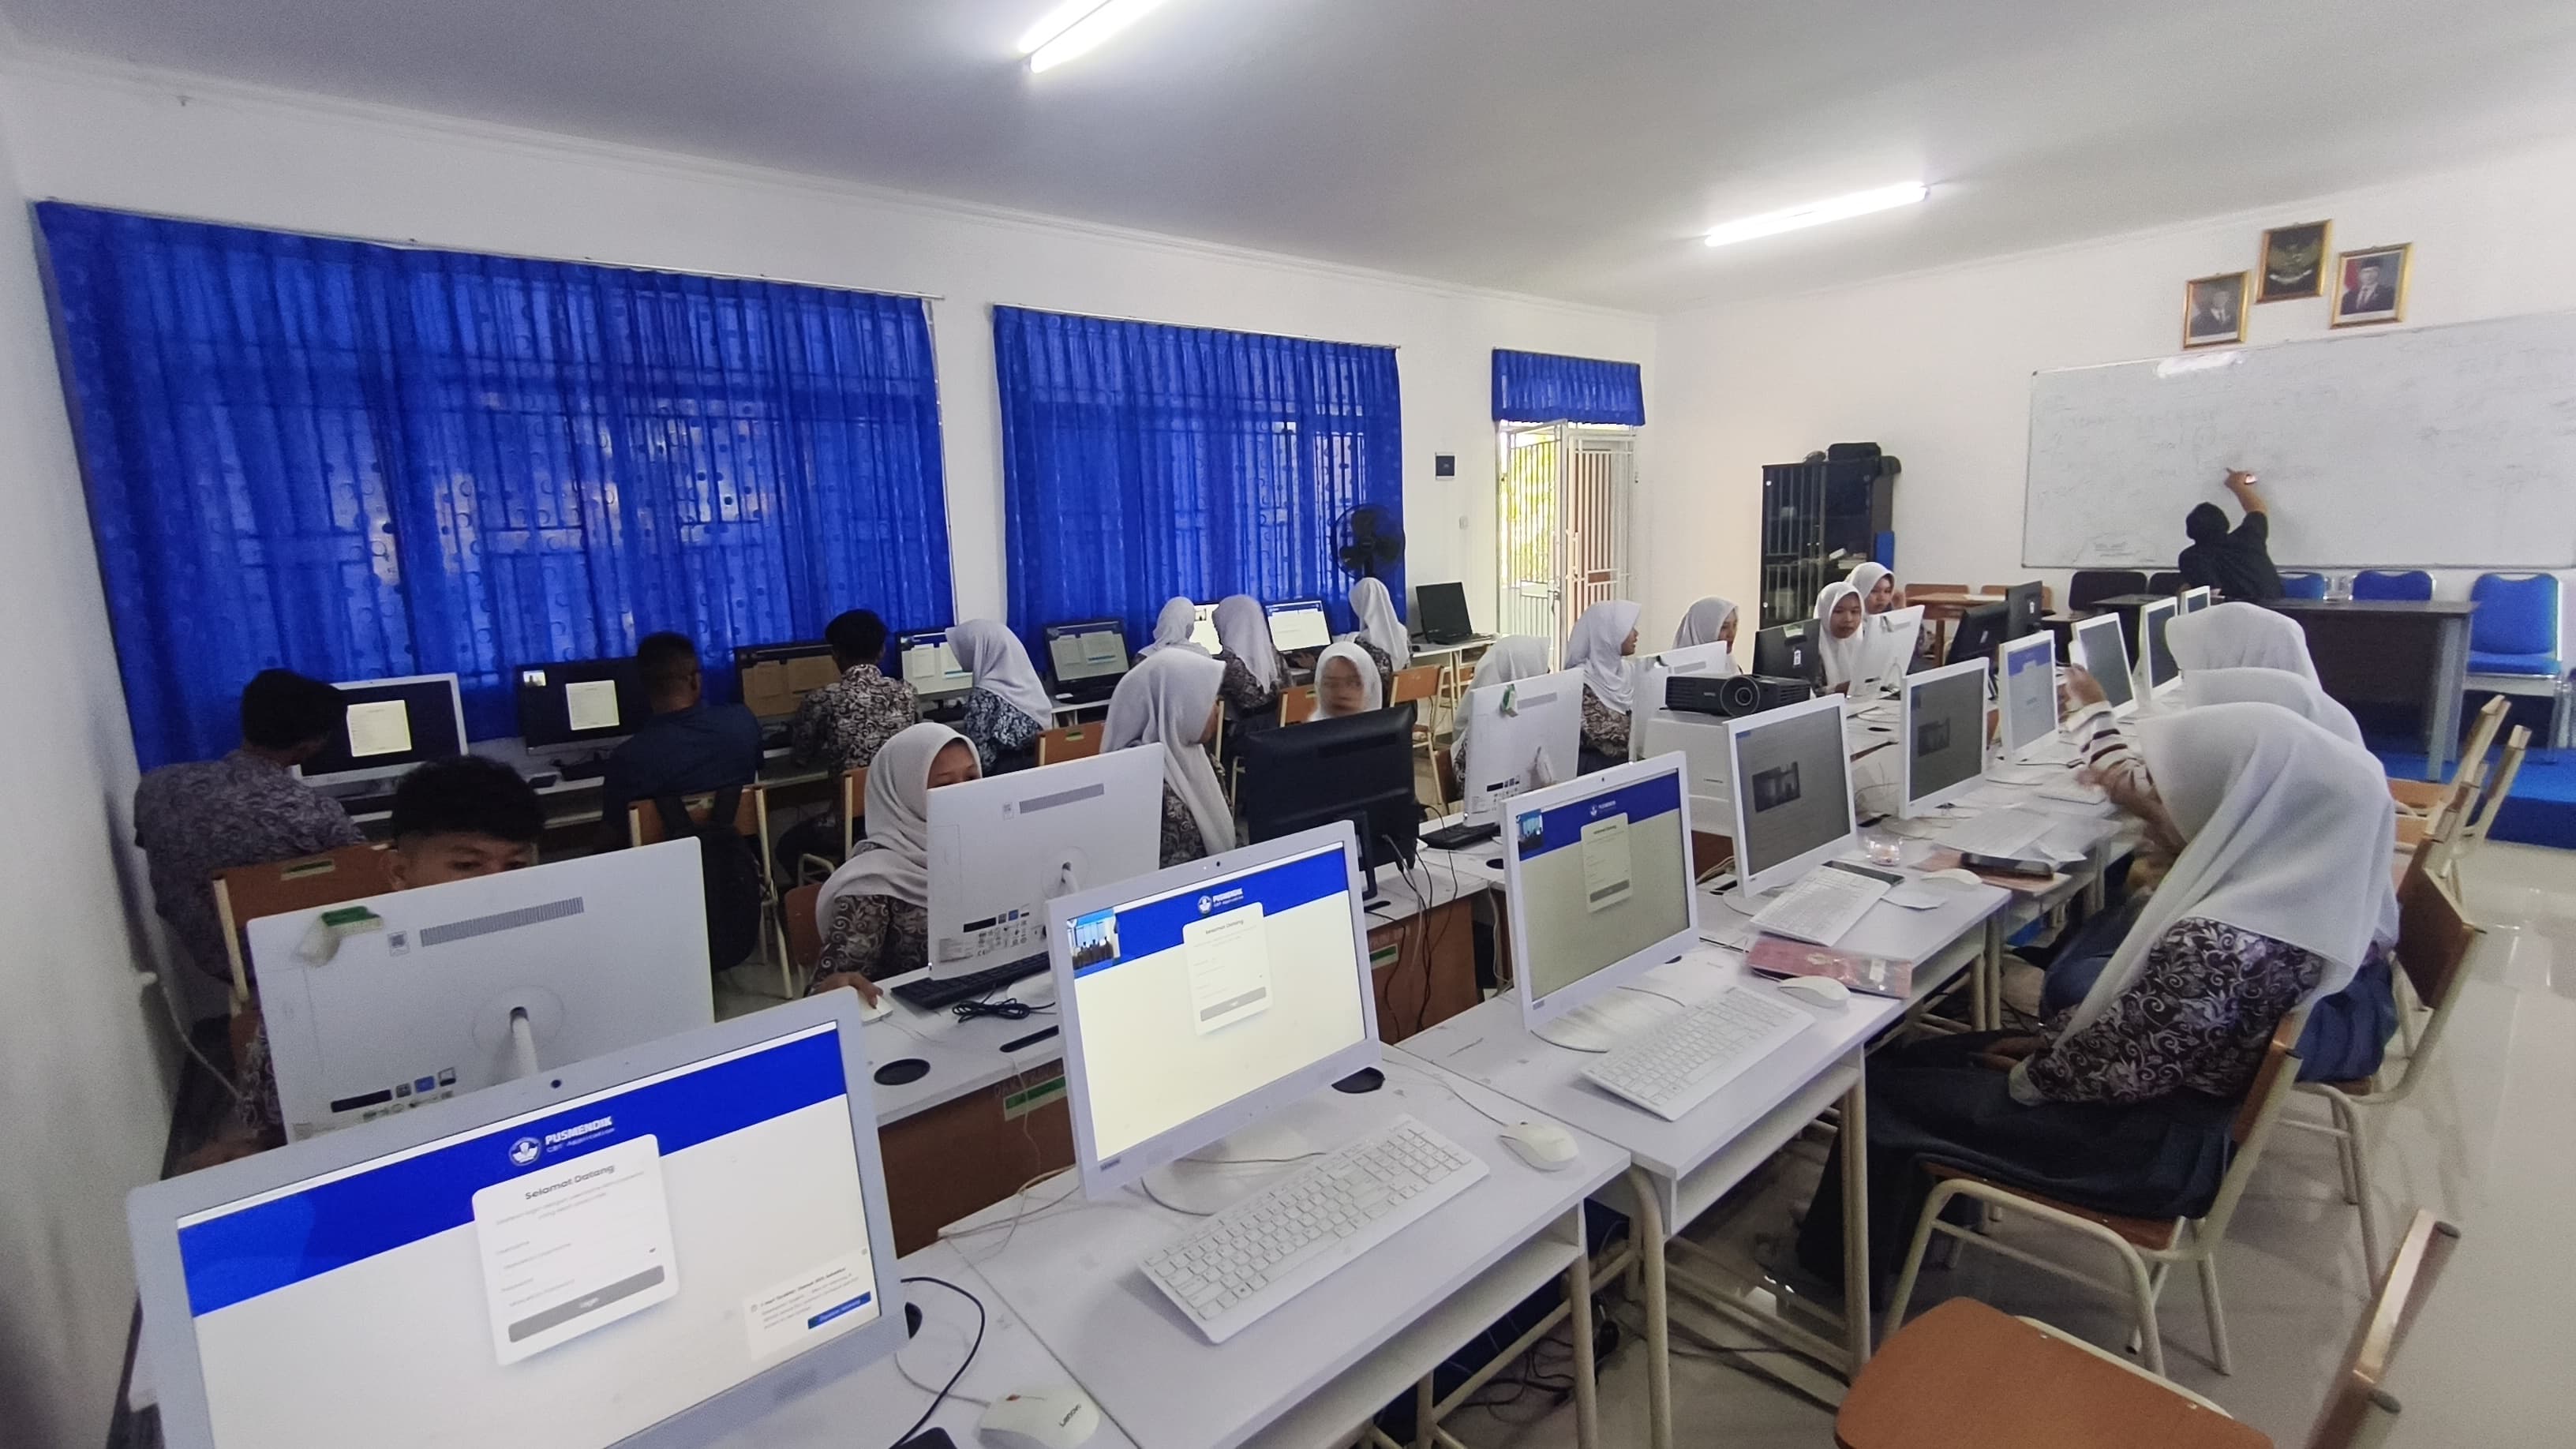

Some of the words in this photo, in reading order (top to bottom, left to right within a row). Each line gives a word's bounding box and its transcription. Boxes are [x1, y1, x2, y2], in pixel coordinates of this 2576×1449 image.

[545, 1116, 612, 1145] PUSMENDIK
[525, 1178, 572, 1200] Selamat
[574, 1165, 615, 1185] Datang
